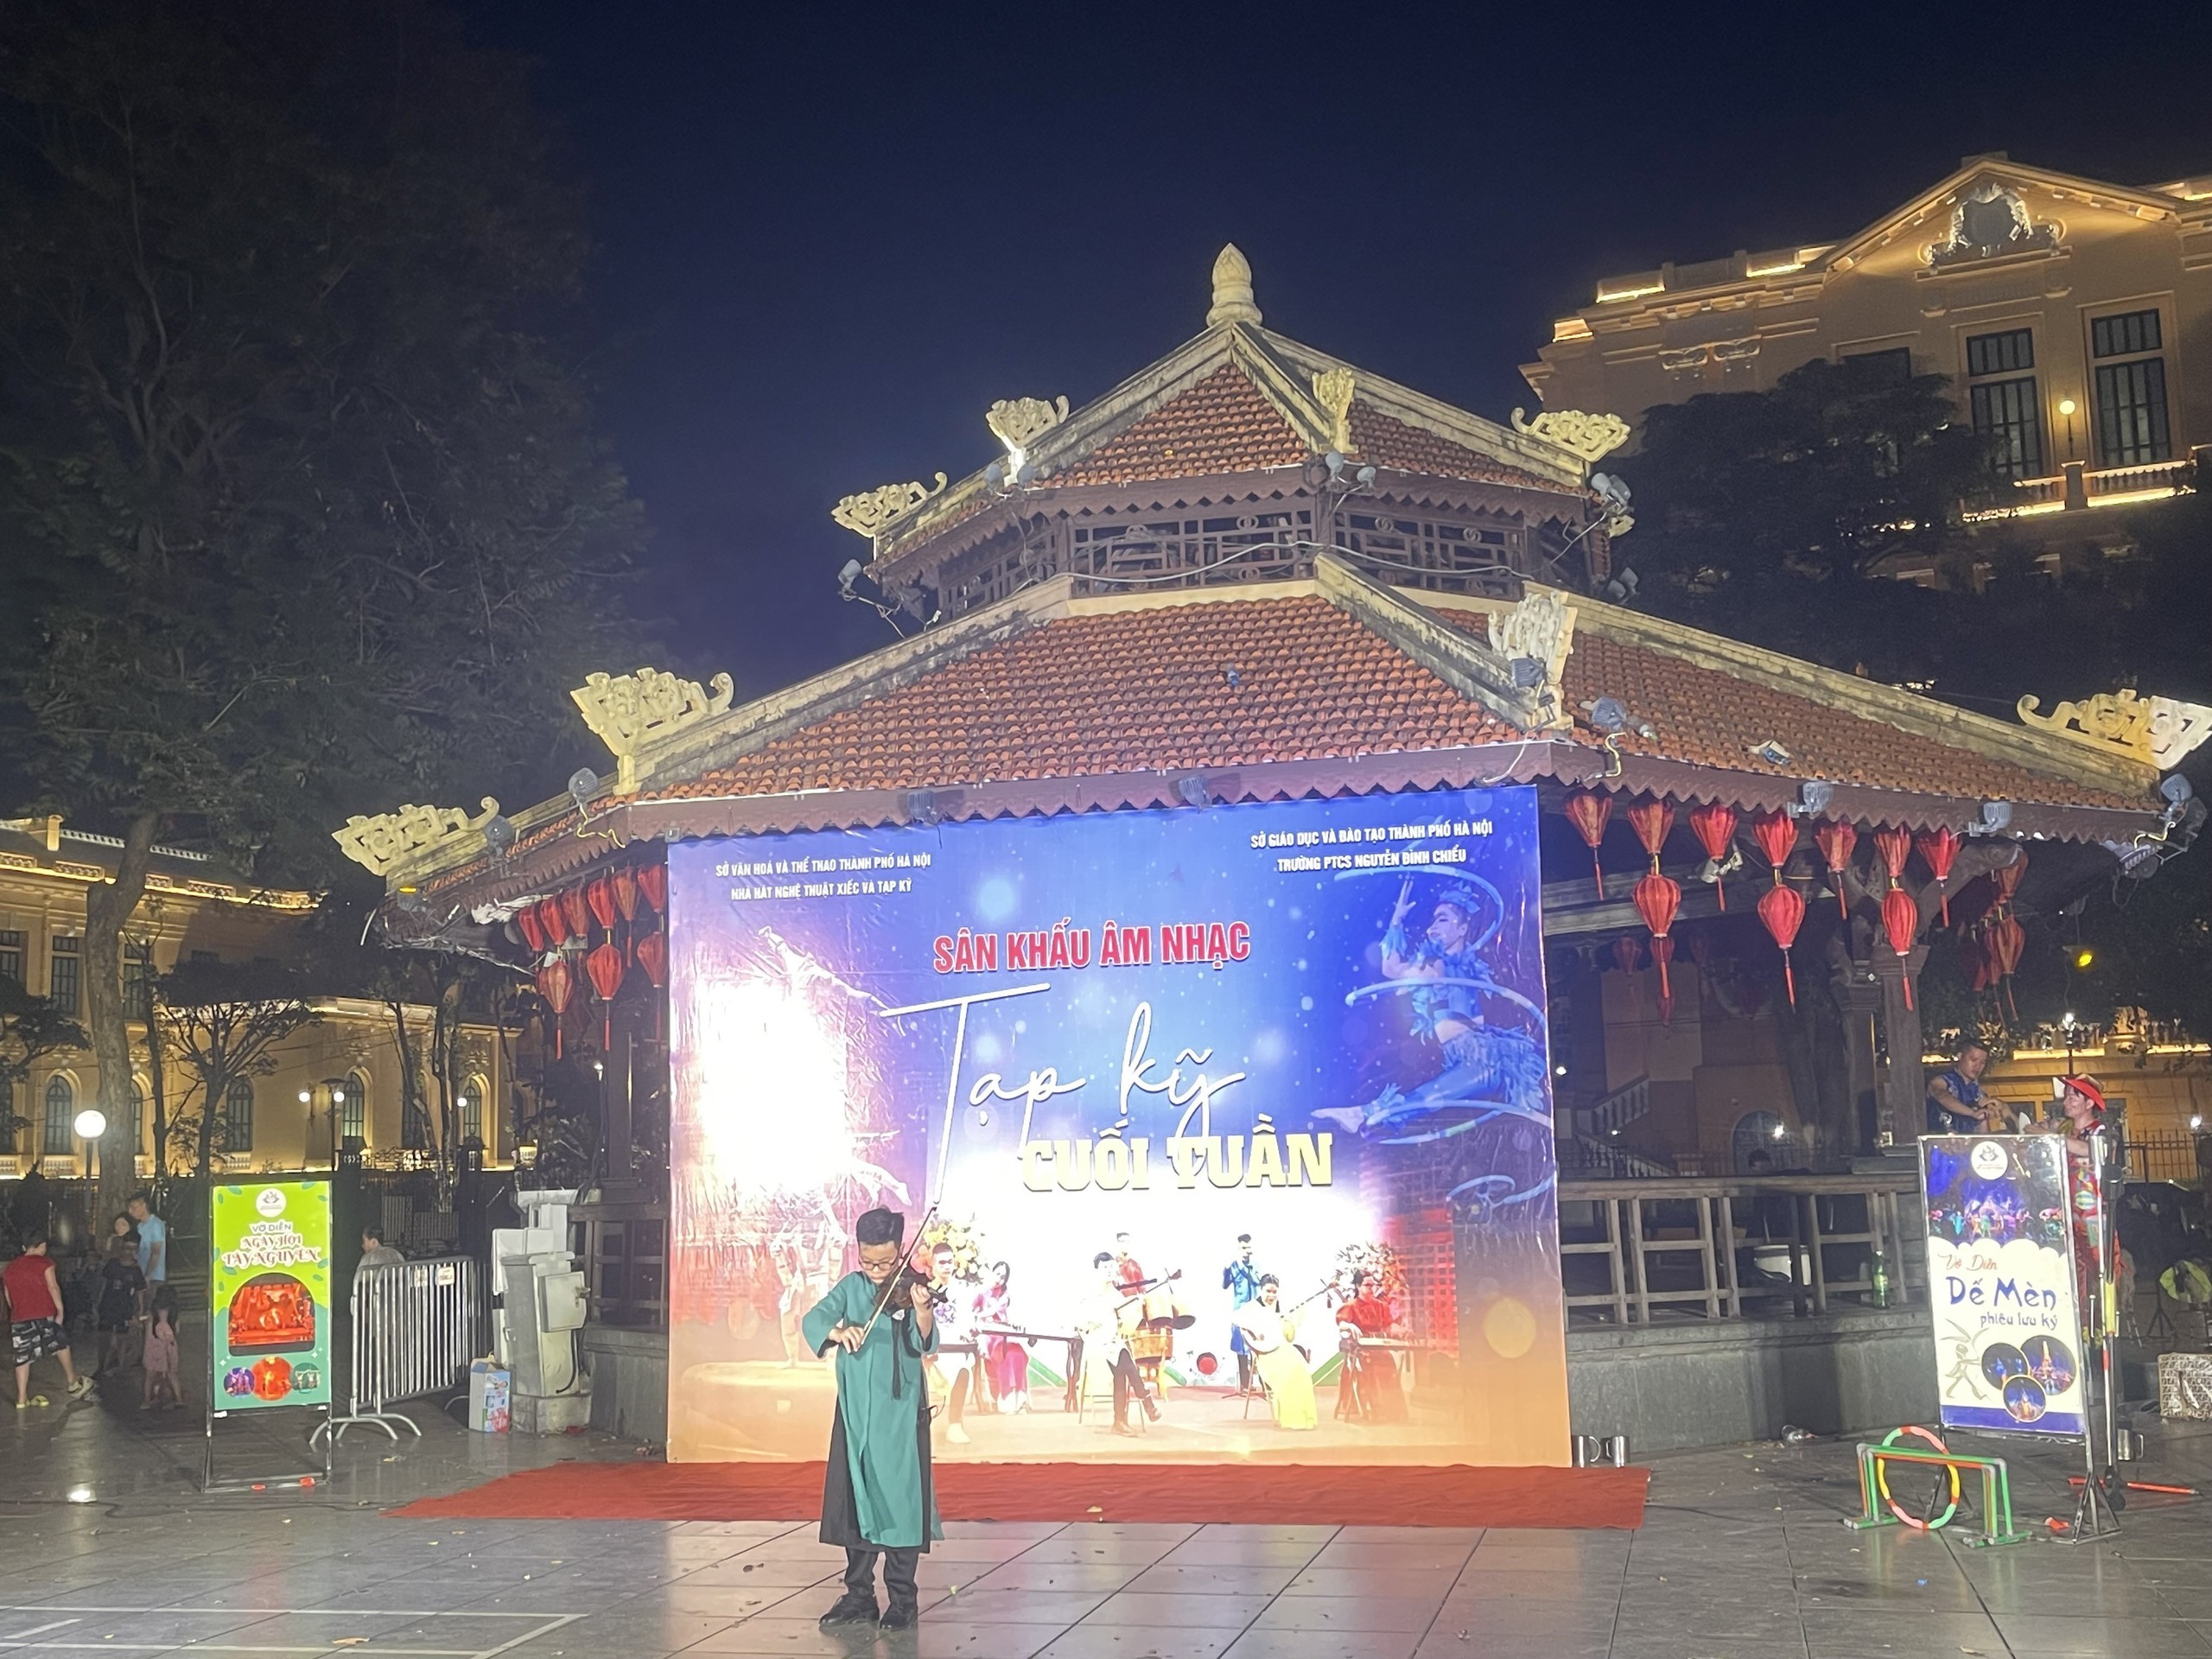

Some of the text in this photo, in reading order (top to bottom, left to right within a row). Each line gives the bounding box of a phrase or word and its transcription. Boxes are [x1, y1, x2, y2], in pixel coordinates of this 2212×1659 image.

[1250, 819, 1492, 848] SỞ GIÁO DỤC VÀ ĐÀO TẠO THÀNH PHỐ HÀ NỘI
[715, 851, 931, 876] SỞ VĂN HOÁ VÀ THỂ THAO THÀNH PHỐ HÀ NỘI
[1277, 844, 1466, 872] TRƯỜNG PTCS NGUYỄN ĐÌNH CHIỂU
[731, 877, 912, 900] NHÀ HÁT NGHỆ THUẬT XIẾC VÀ TẠP KỸ
[933, 917, 1250, 975] SÂN KHẤU ÂM NHẠC
[880, 982, 1246, 1205] Tạp kỹ
[1023, 1113, 1332, 1192] CUỐI TUẦN
[1946, 1276, 2056, 1311] Dế Mèn
[1980, 1312, 2013, 1328] phiêu
[2018, 1313, 2037, 1325] lưu
